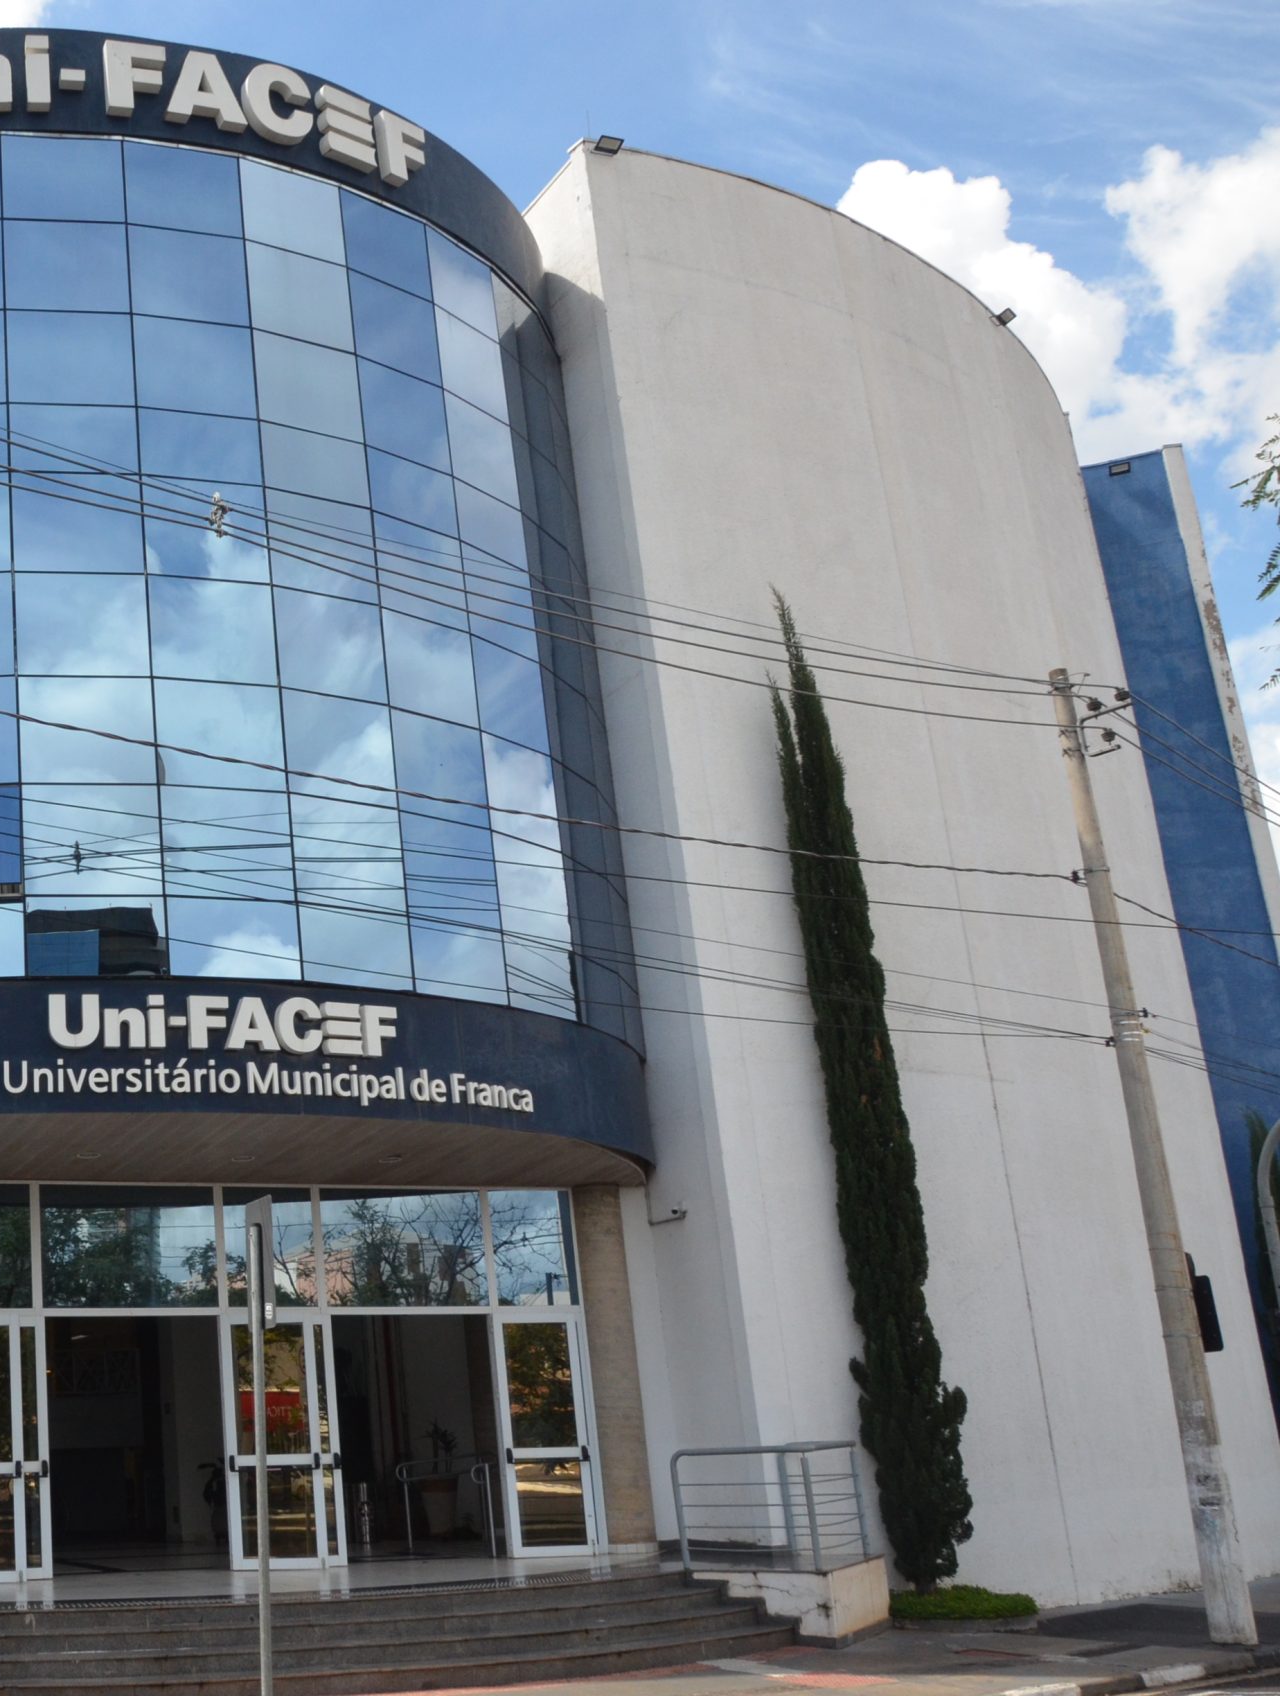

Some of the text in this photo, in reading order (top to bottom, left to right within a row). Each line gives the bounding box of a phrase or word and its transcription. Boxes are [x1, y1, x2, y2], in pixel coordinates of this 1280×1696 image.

[48, 993, 397, 1057] Uni-FACEF
[3, 1057, 241, 1094] Universitário
[246, 1061, 406, 1106] Municipal
[409, 1068, 447, 1102] de
[449, 1072, 534, 1112] Franca
